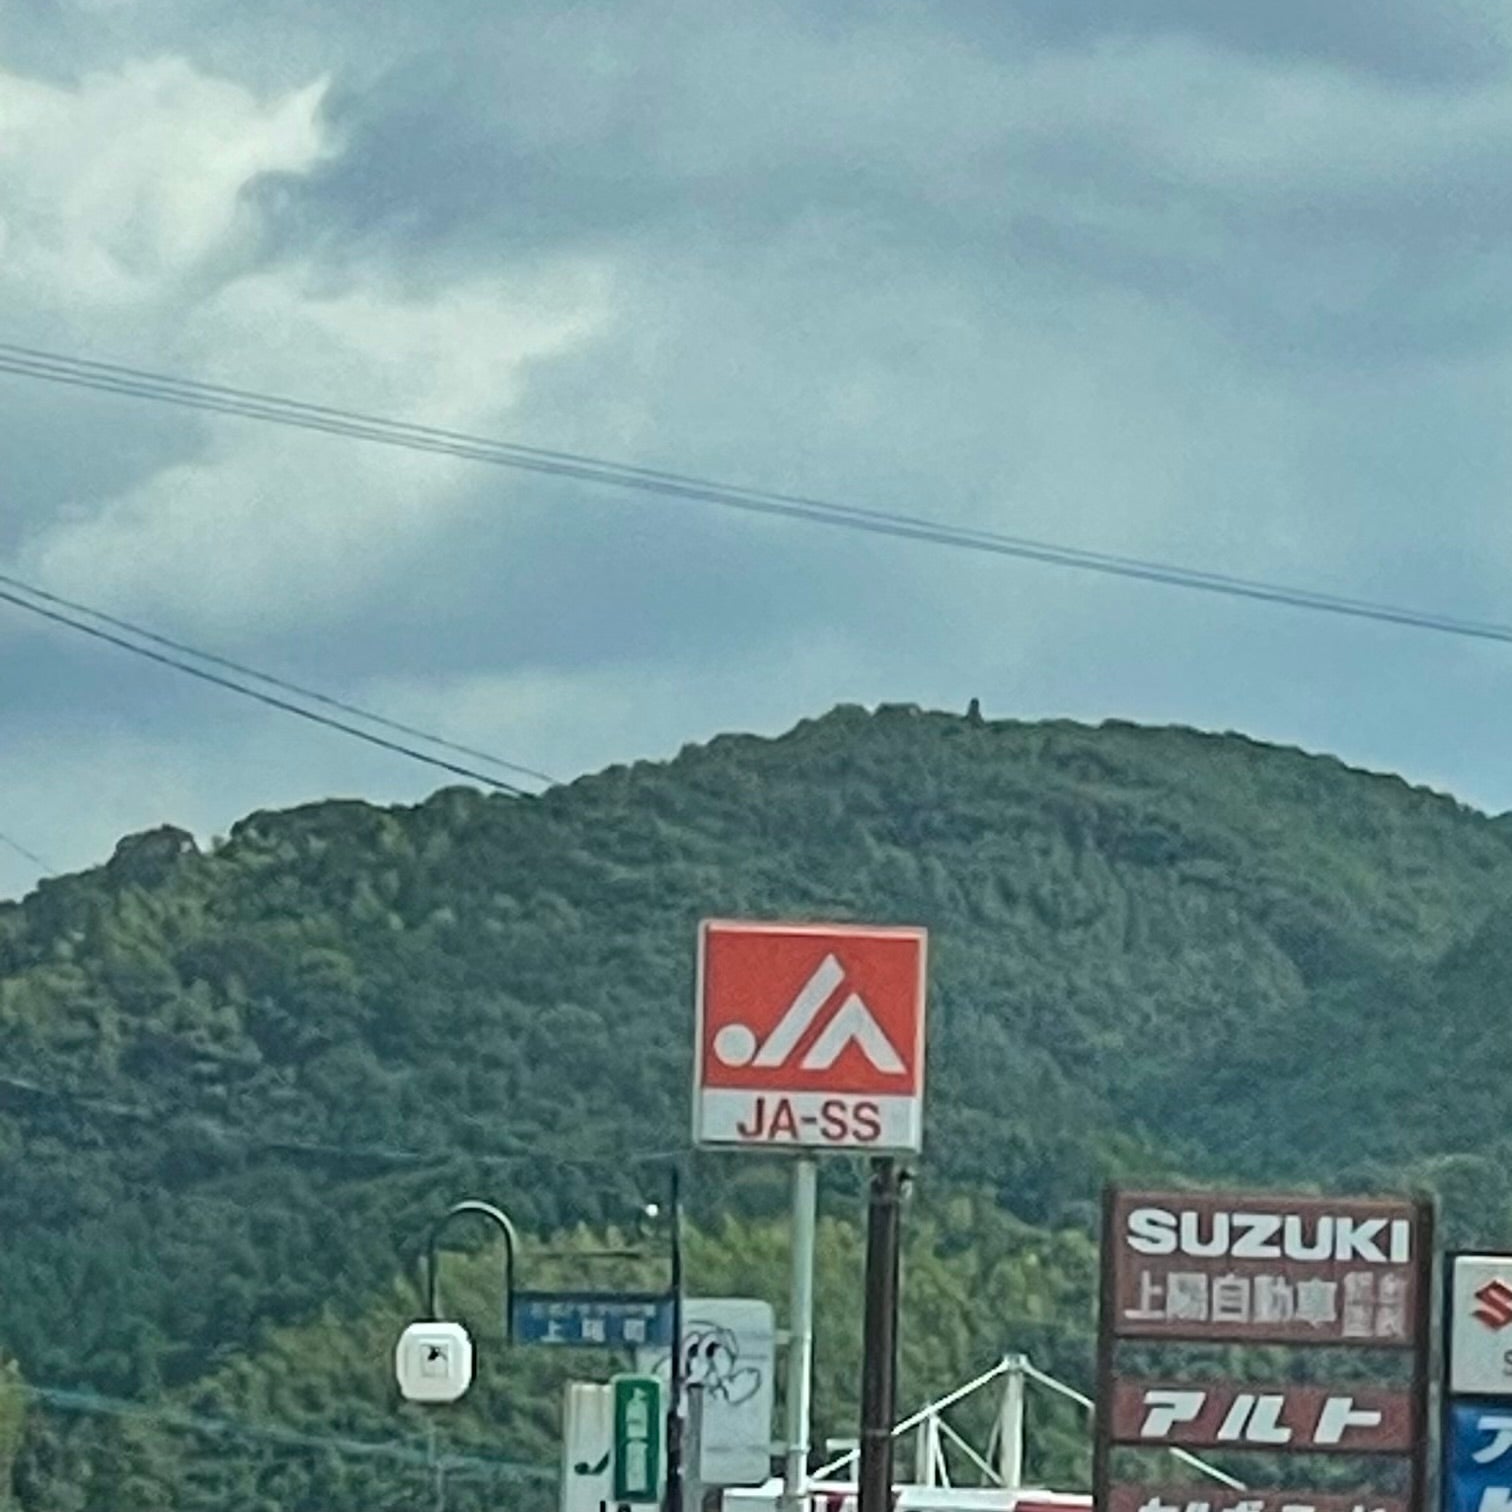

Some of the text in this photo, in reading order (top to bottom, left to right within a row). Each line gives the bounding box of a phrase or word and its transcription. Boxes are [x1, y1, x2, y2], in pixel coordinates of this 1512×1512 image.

[737, 1096, 882, 1144] JA-SS
[1126, 1208, 1410, 1263] SUZUKI
[1140, 1391, 1382, 1444] アルト
